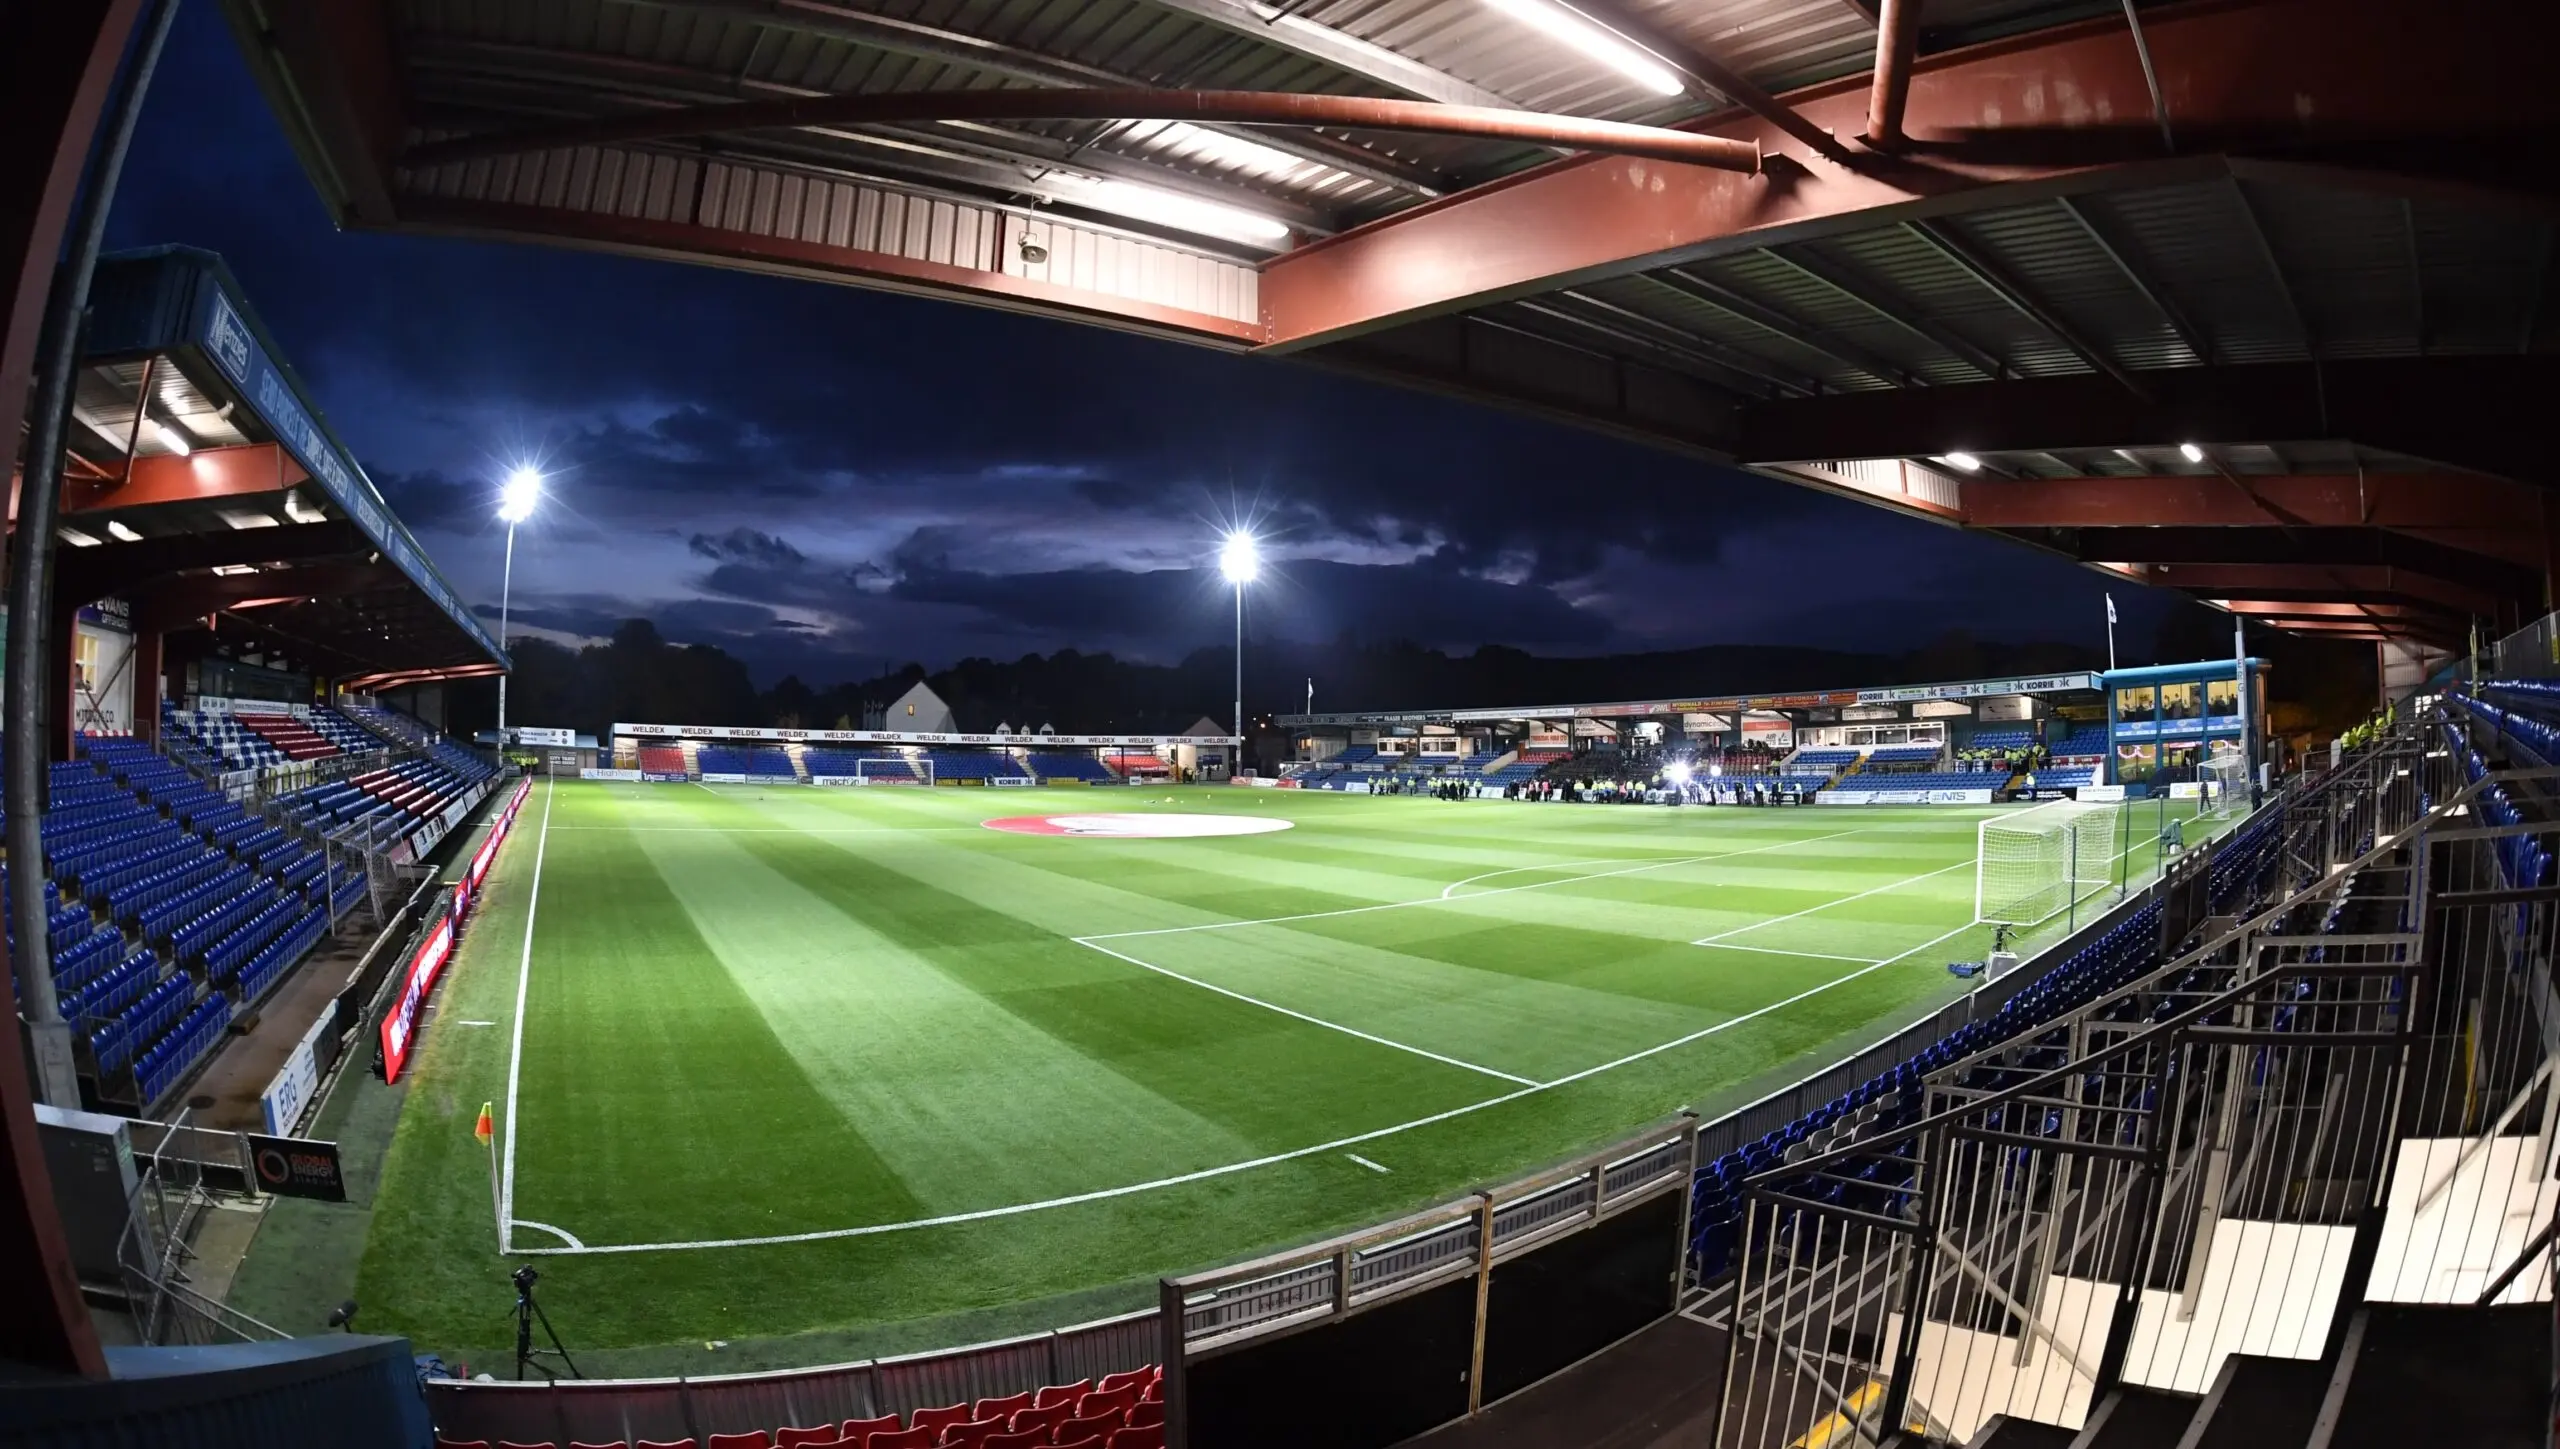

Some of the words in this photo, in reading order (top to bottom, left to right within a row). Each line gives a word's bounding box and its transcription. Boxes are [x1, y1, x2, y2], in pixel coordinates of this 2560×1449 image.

[1858, 692, 1884, 701] KORRIE
[2026, 680, 2054, 690] KORRIE
[632, 726, 665, 734] WELDEX
[680, 727, 713, 735] WELDEX
[729, 729, 761, 737] WELDEX
[916, 734, 947, 742] WELDEX
[1047, 736, 1075, 744] WELDEX
[278, 1073, 297, 1119] ERG
[290, 1153, 333, 1167] GLOBAL
[292, 1164, 335, 1177] ENERGY
